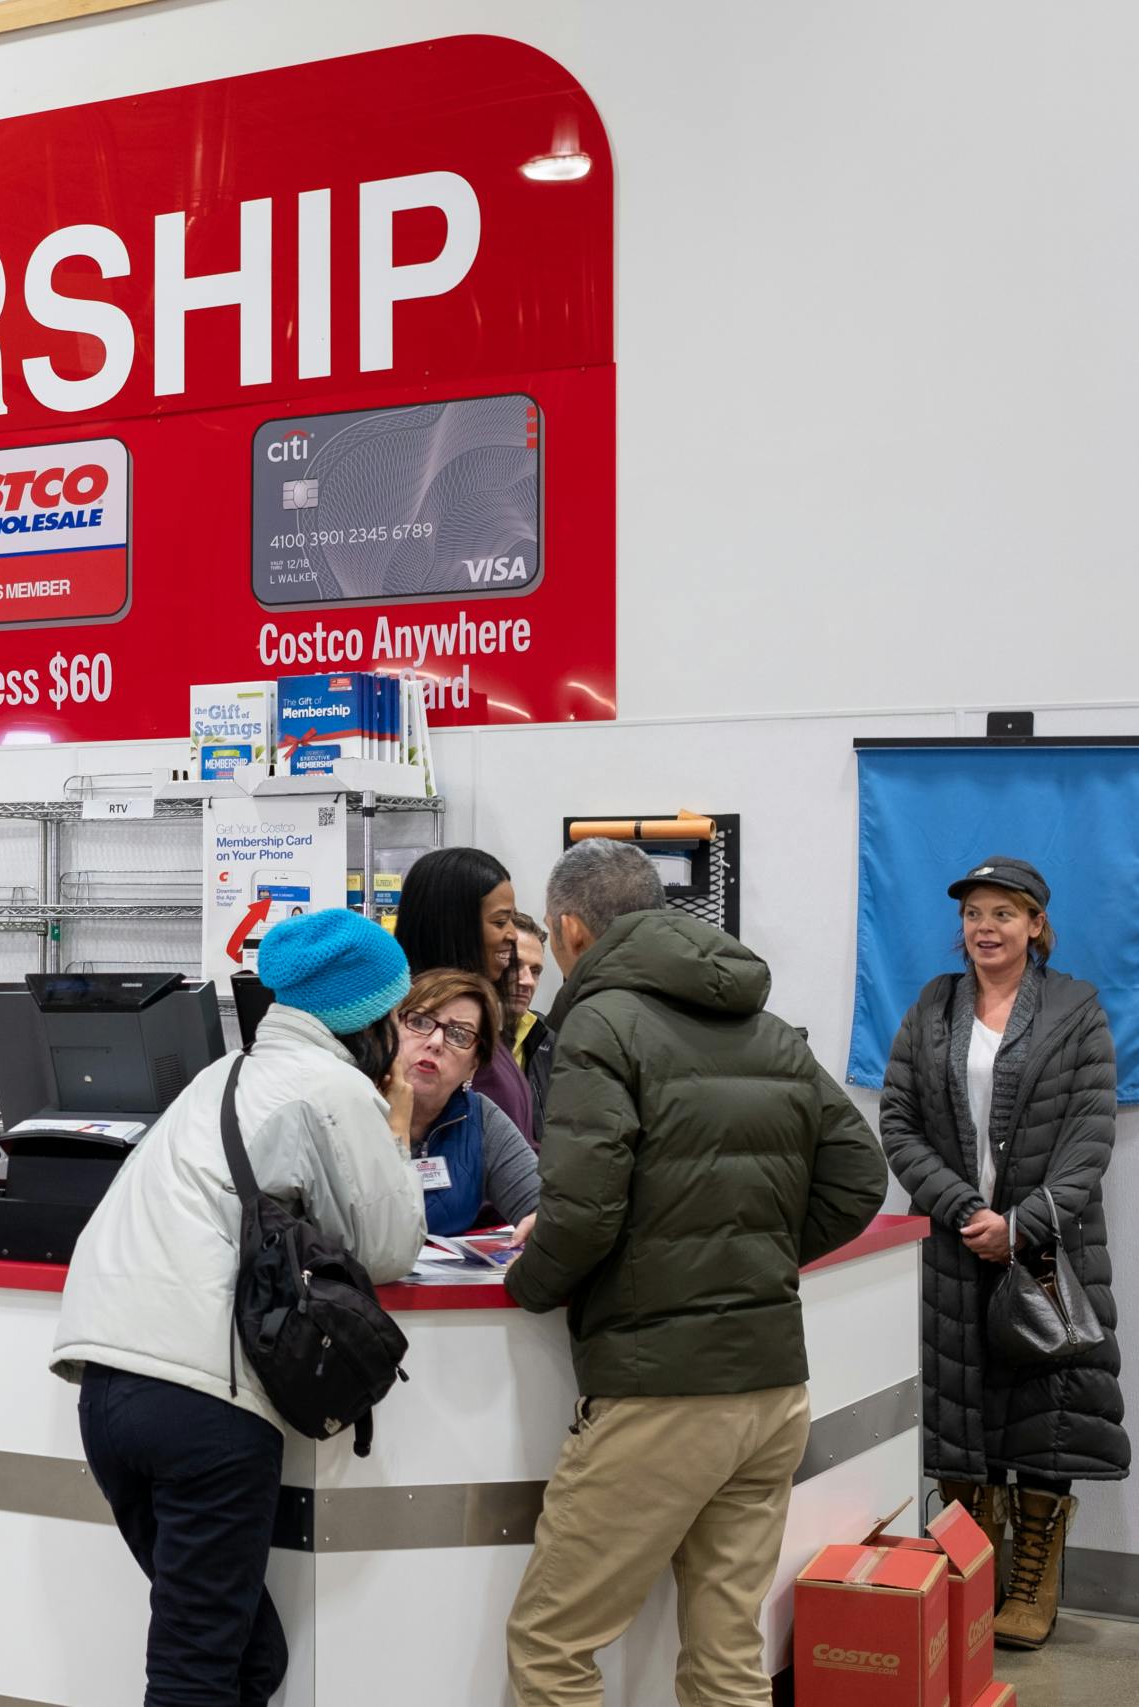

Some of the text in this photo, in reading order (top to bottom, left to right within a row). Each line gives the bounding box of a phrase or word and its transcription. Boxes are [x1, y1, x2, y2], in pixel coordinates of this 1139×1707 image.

[267, 434, 308, 462] citi
[270, 522, 433, 548] 4100 3901 2345 6789
[287, 558, 310, 569] 12/18
[461, 556, 527, 583] VISA
[270, 572, 317, 584] L WALKER
[6, 579, 71, 599] MEMBER
[259, 611, 531, 667] Costco Anywhere
[49, 651, 112, 710] $60
[399, 667, 469, 710] ard
[283, 695, 322, 706] The Gift of
[194, 704, 250, 719] the Gift of
[282, 704, 350, 719] Membership
[195, 721, 262, 739] Savings
[205, 758, 249, 769] MEMBERSHIP
[109, 804, 128, 813] RTV
[216, 822, 295, 835] Get Your Costco
[216, 835, 312, 848] Membership Card
[216, 850, 293, 861] on Your Phone
[812, 1643, 900, 1668] COSTCO
